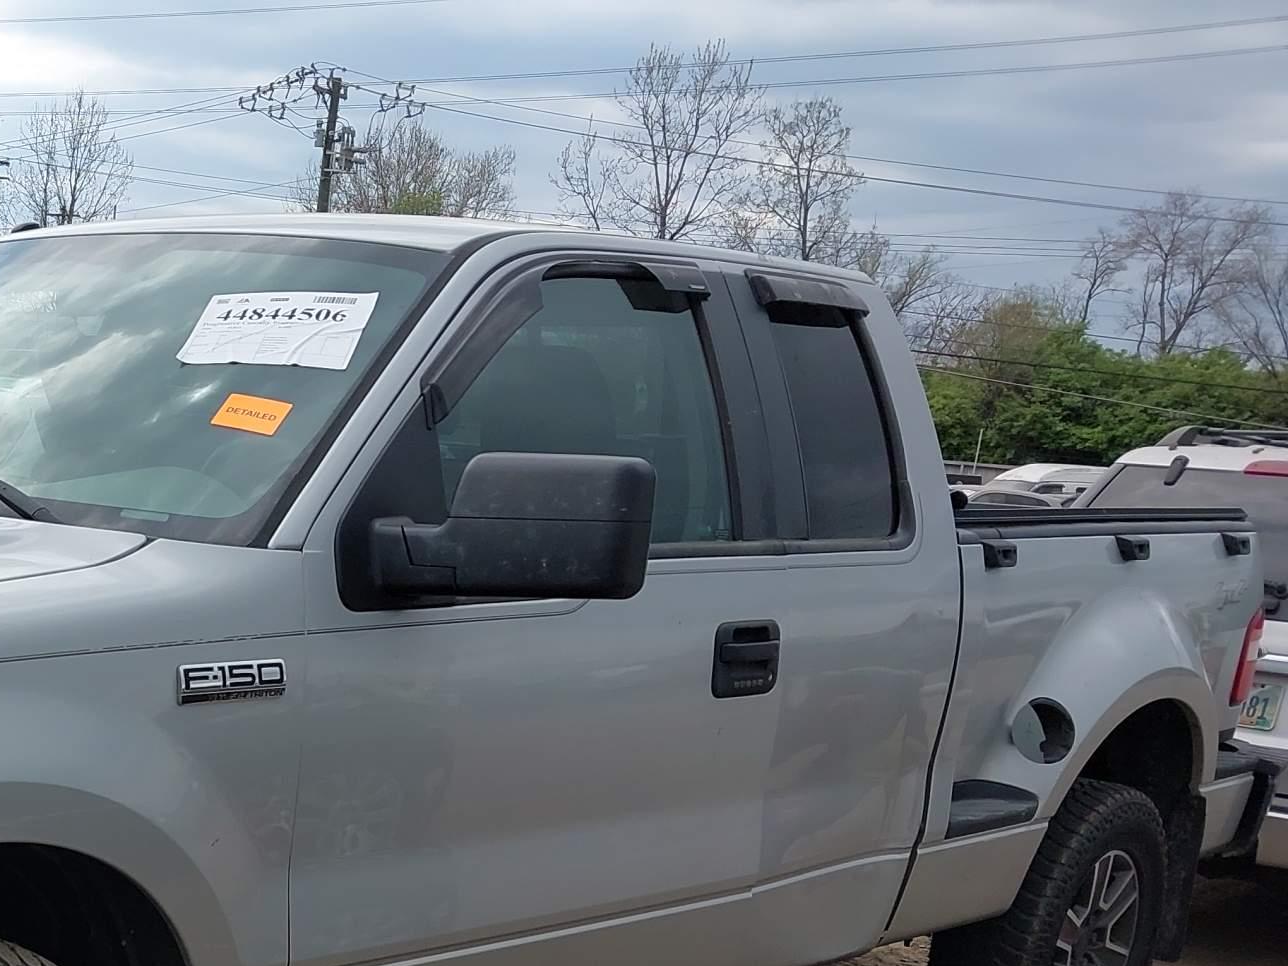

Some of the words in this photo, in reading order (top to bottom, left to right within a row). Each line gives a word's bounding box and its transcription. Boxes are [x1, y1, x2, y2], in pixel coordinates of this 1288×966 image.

[215, 307, 350, 323] 44844506
[225, 406, 277, 422] DETAILED
[182, 662, 285, 690] F-150
